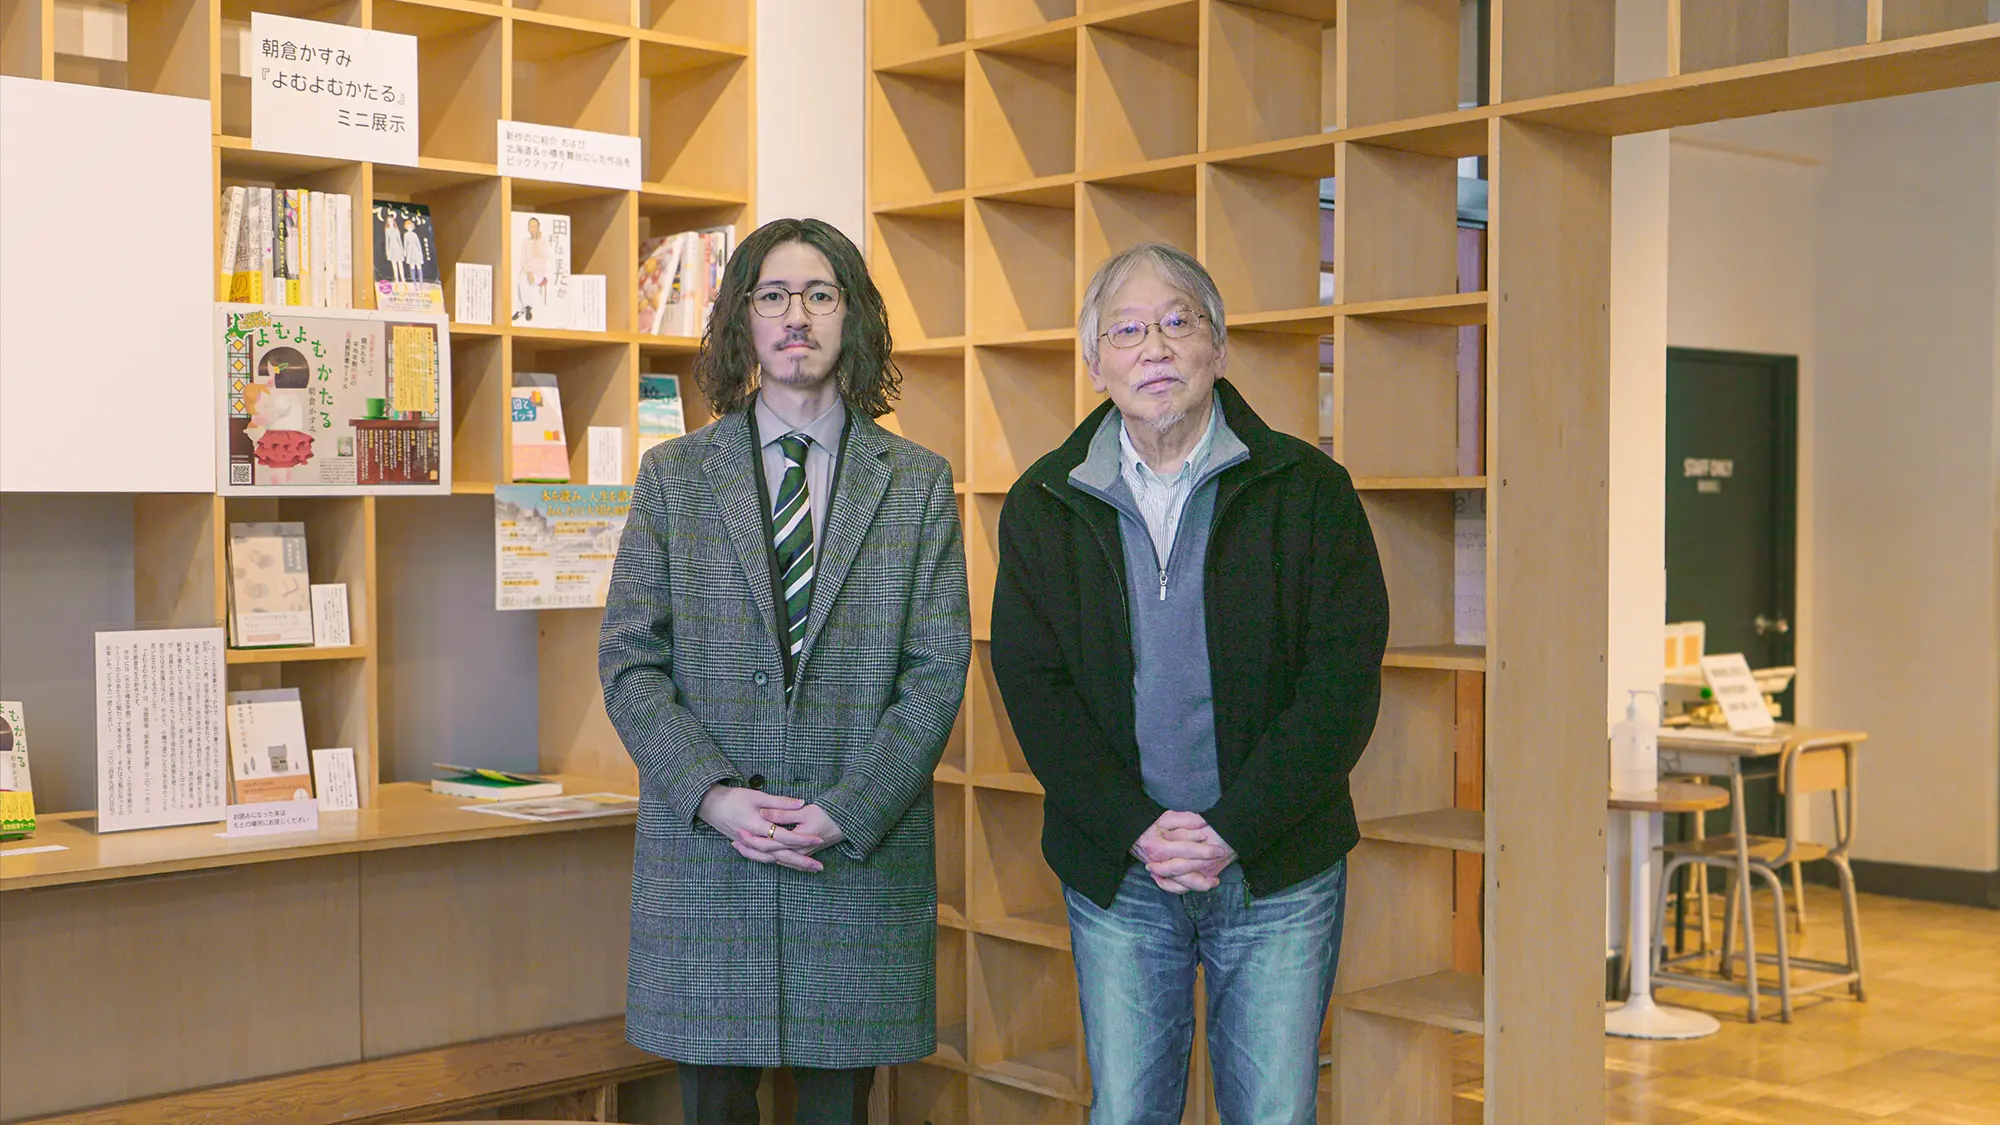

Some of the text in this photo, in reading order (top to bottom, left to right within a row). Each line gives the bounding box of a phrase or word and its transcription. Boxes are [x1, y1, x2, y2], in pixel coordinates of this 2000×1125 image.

[262, 38, 352, 68] 朝倉かすみ
[261, 67, 406, 106] 『よむよむかたる』
[337, 109, 406, 133] ミニ展示
[548, 218, 568, 299] 田村はまだか
[256, 321, 334, 428] よむよむかたる
[308, 387, 317, 433] 朝倉かすみ
[1683, 458, 1733, 478] STAFF ONLY
[233, 810, 286, 820] お読みになった本は
